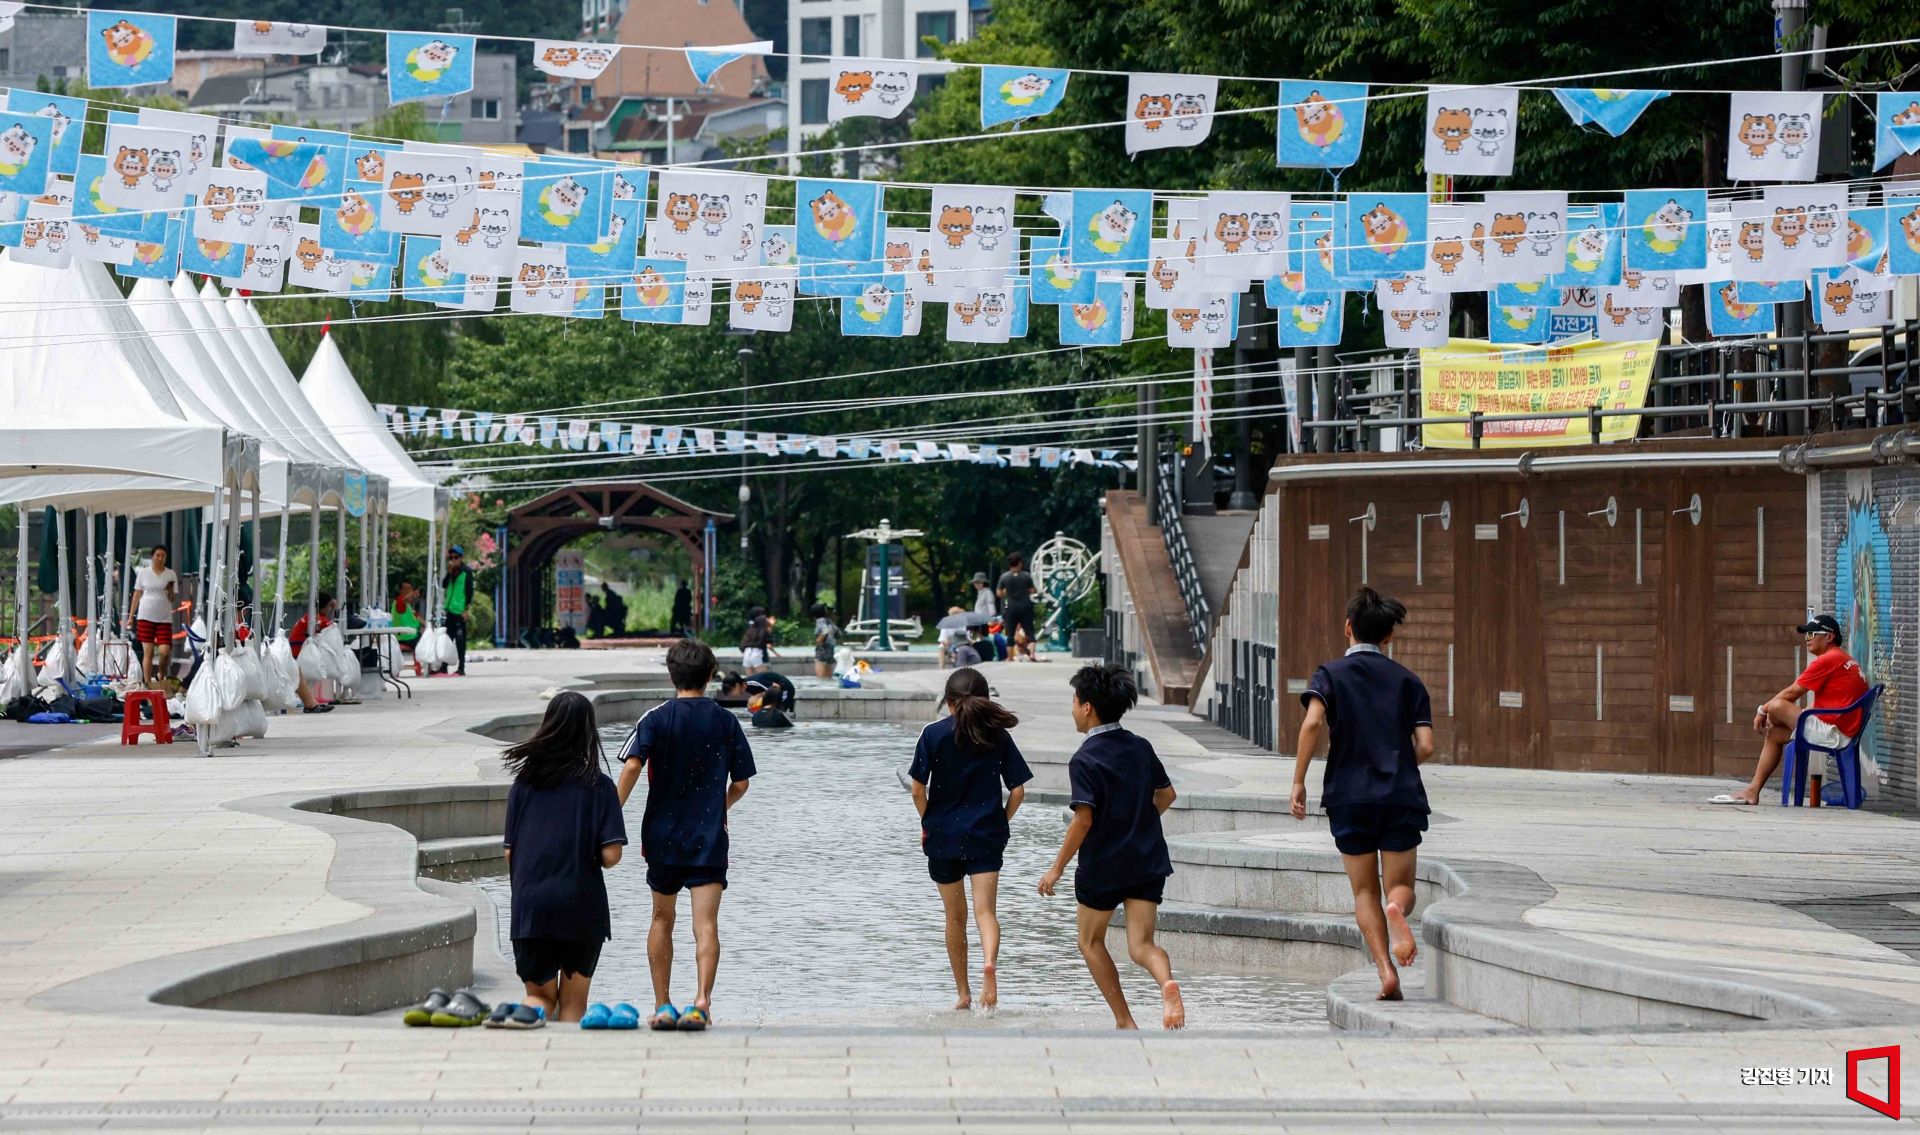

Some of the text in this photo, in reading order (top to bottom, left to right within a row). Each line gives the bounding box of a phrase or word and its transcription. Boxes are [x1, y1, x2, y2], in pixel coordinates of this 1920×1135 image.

[1553, 316, 1595, 331] 자전거
[1497, 370, 1521, 389] 출입금지
[1552, 368, 1565, 388] 금지
[1569, 367, 1587, 386] 다이빙
[1589, 365, 1602, 384] 금지
[1459, 393, 1472, 412] 금지
